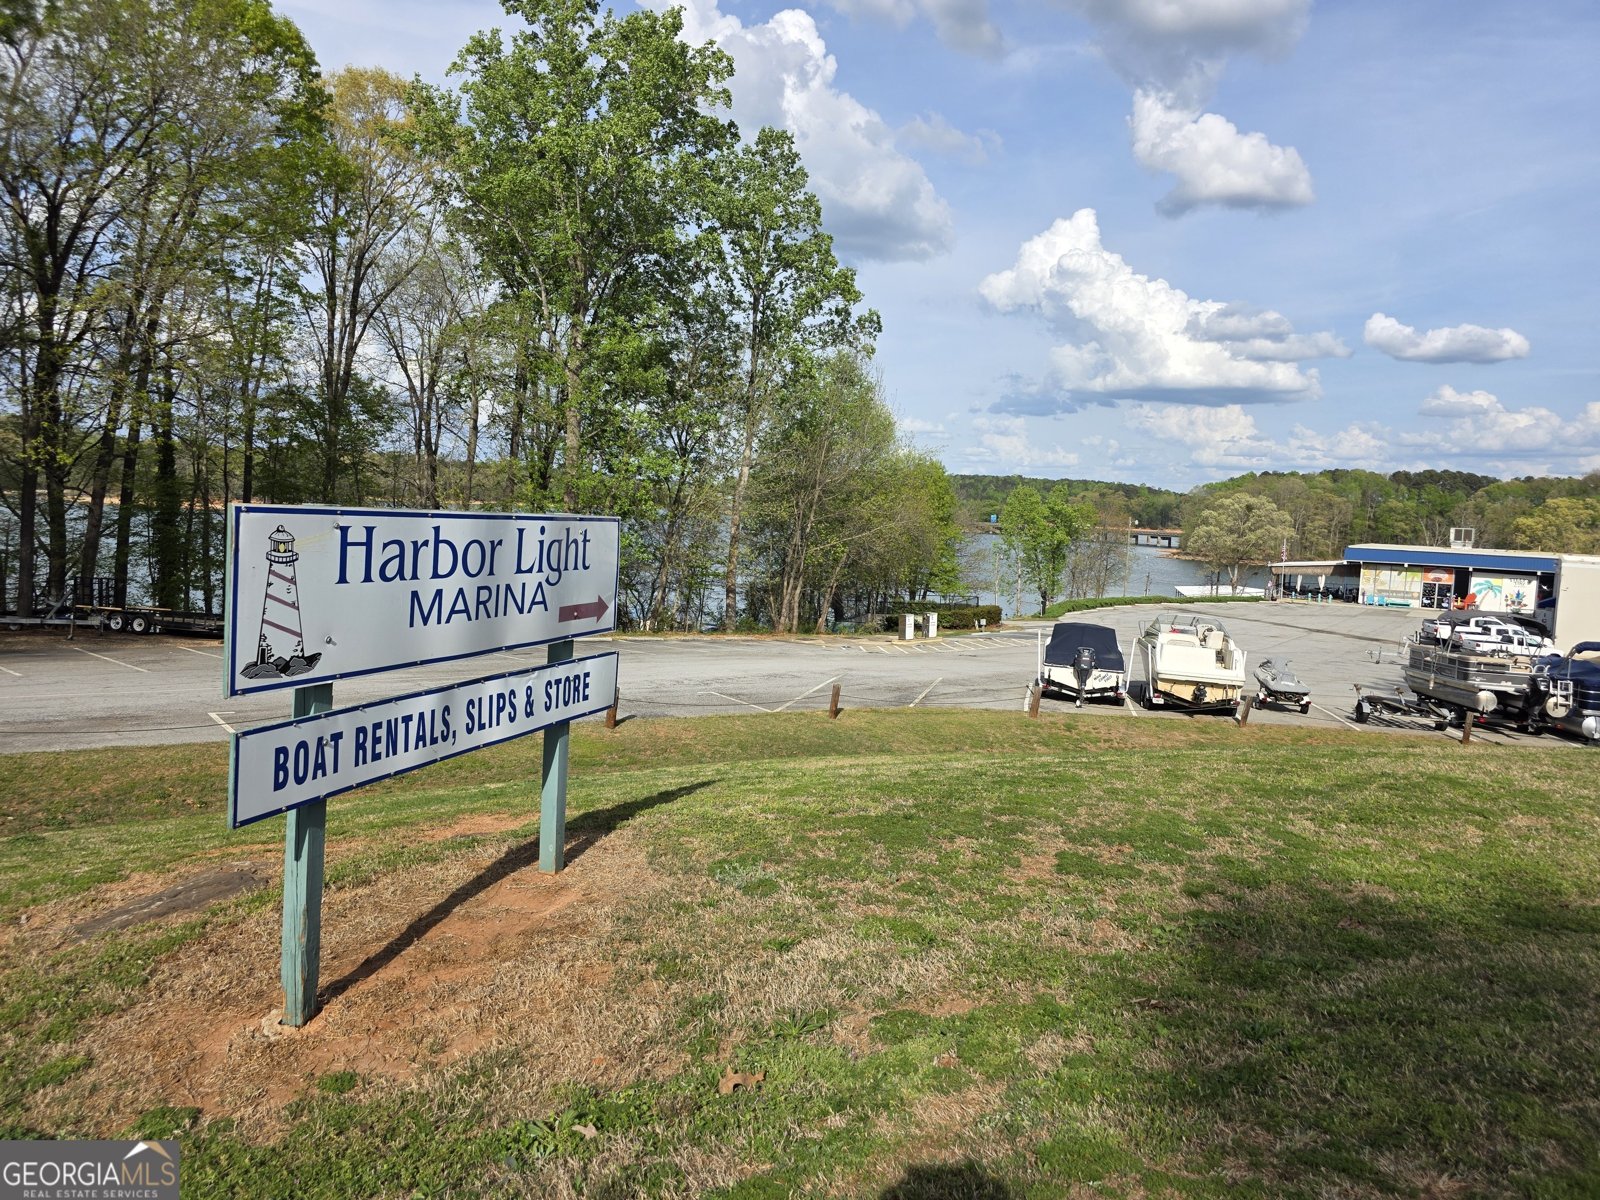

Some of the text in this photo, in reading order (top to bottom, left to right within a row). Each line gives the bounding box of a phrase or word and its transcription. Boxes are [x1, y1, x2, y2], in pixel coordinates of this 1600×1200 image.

[335, 525, 591, 586] Harbor Light
[409, 581, 549, 629] MARINA
[273, 672, 591, 792] BOAT RENTALS, SLIPS & STORE
